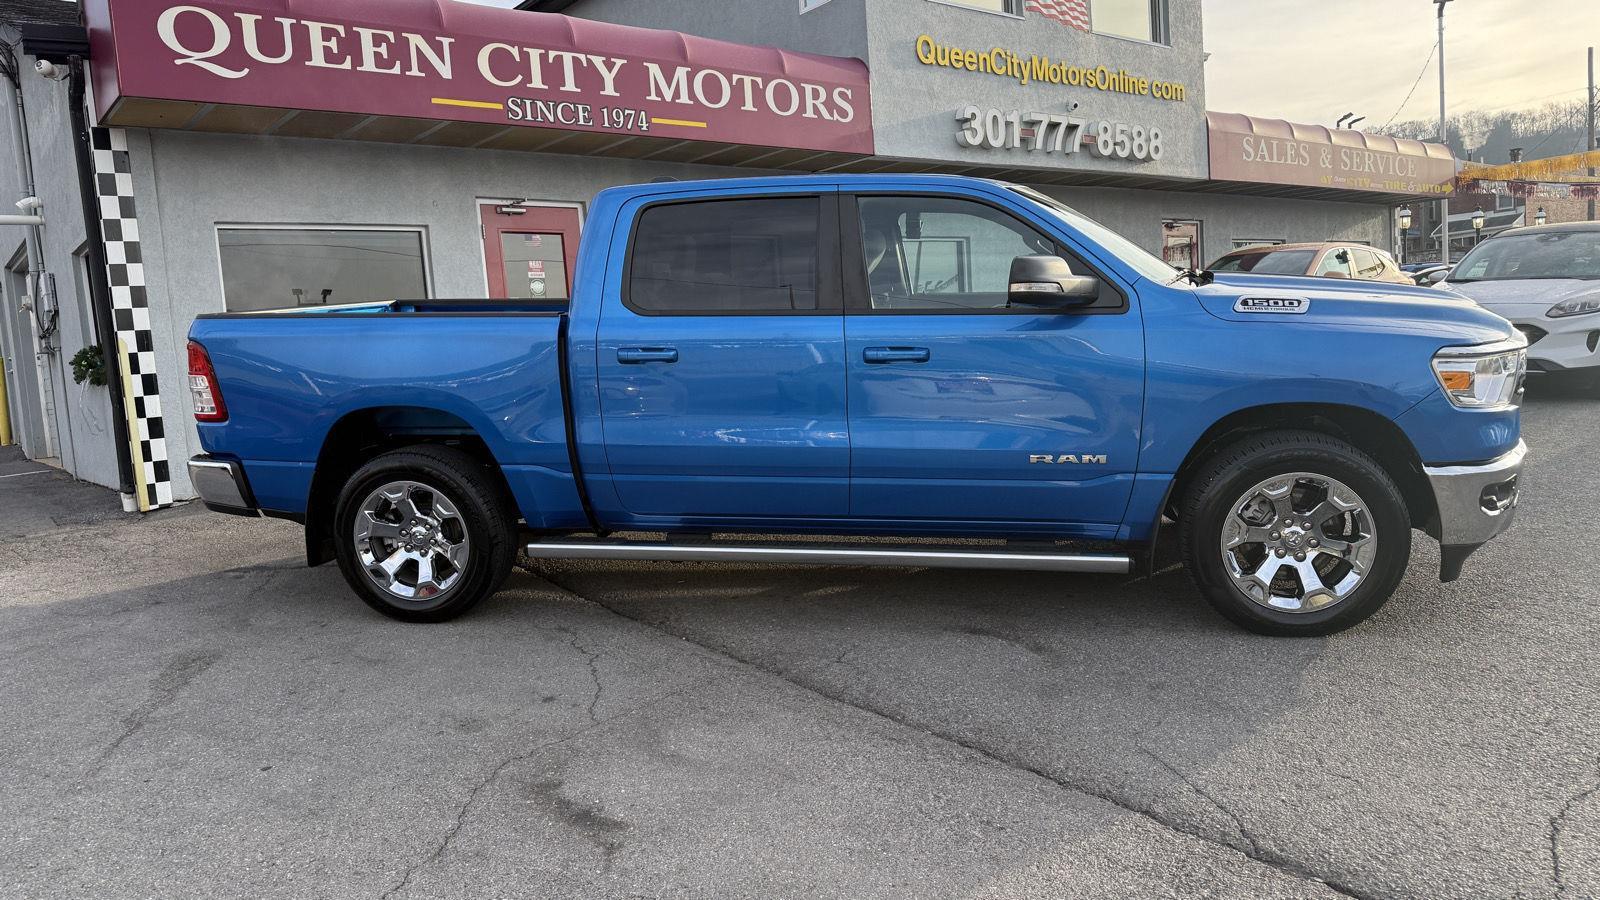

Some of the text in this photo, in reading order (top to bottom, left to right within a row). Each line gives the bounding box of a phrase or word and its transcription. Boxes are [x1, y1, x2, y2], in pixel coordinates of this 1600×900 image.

[156, 5, 855, 124] QUEEN CITY MOTORS
[507, 97, 650, 131] SINCE 1974
[1242, 136, 1417, 178] SALES & SERVICE
[1384, 179, 1407, 191] TIRE
[1407, 181, 1415, 192] &
[1415, 183, 1441, 193] AUTO
[1246, 299, 1299, 307] 1500
[1029, 454, 1108, 464] RAM
